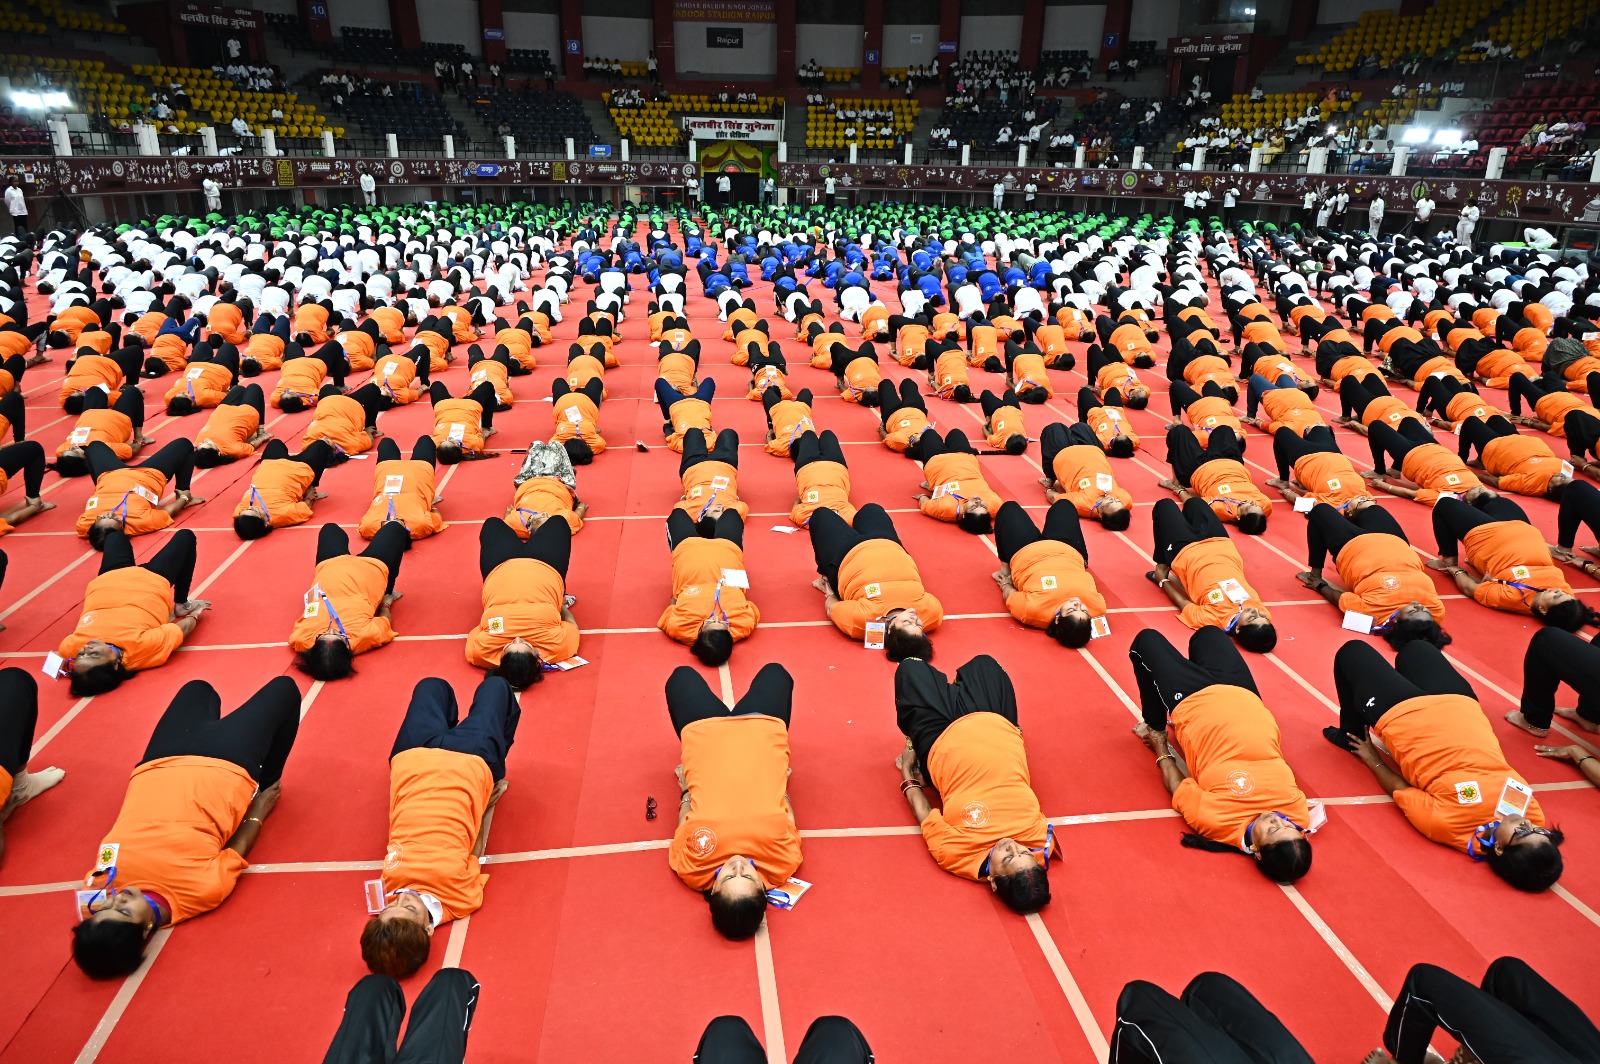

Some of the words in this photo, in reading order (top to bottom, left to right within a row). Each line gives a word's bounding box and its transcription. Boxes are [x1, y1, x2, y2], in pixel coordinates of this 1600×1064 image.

[312, 6, 324, 15] 10
[673, 10, 705, 18] INDOOR
[708, 11, 742, 19] STADIUM
[746, 12, 776, 20] RAIPUR
[717, 36, 739, 45] Raipur
[1109, 36, 1114, 45] 7
[571, 42, 577, 51] 9
[868, 52, 875, 61] 8
[724, 120, 742, 130] सिंह
